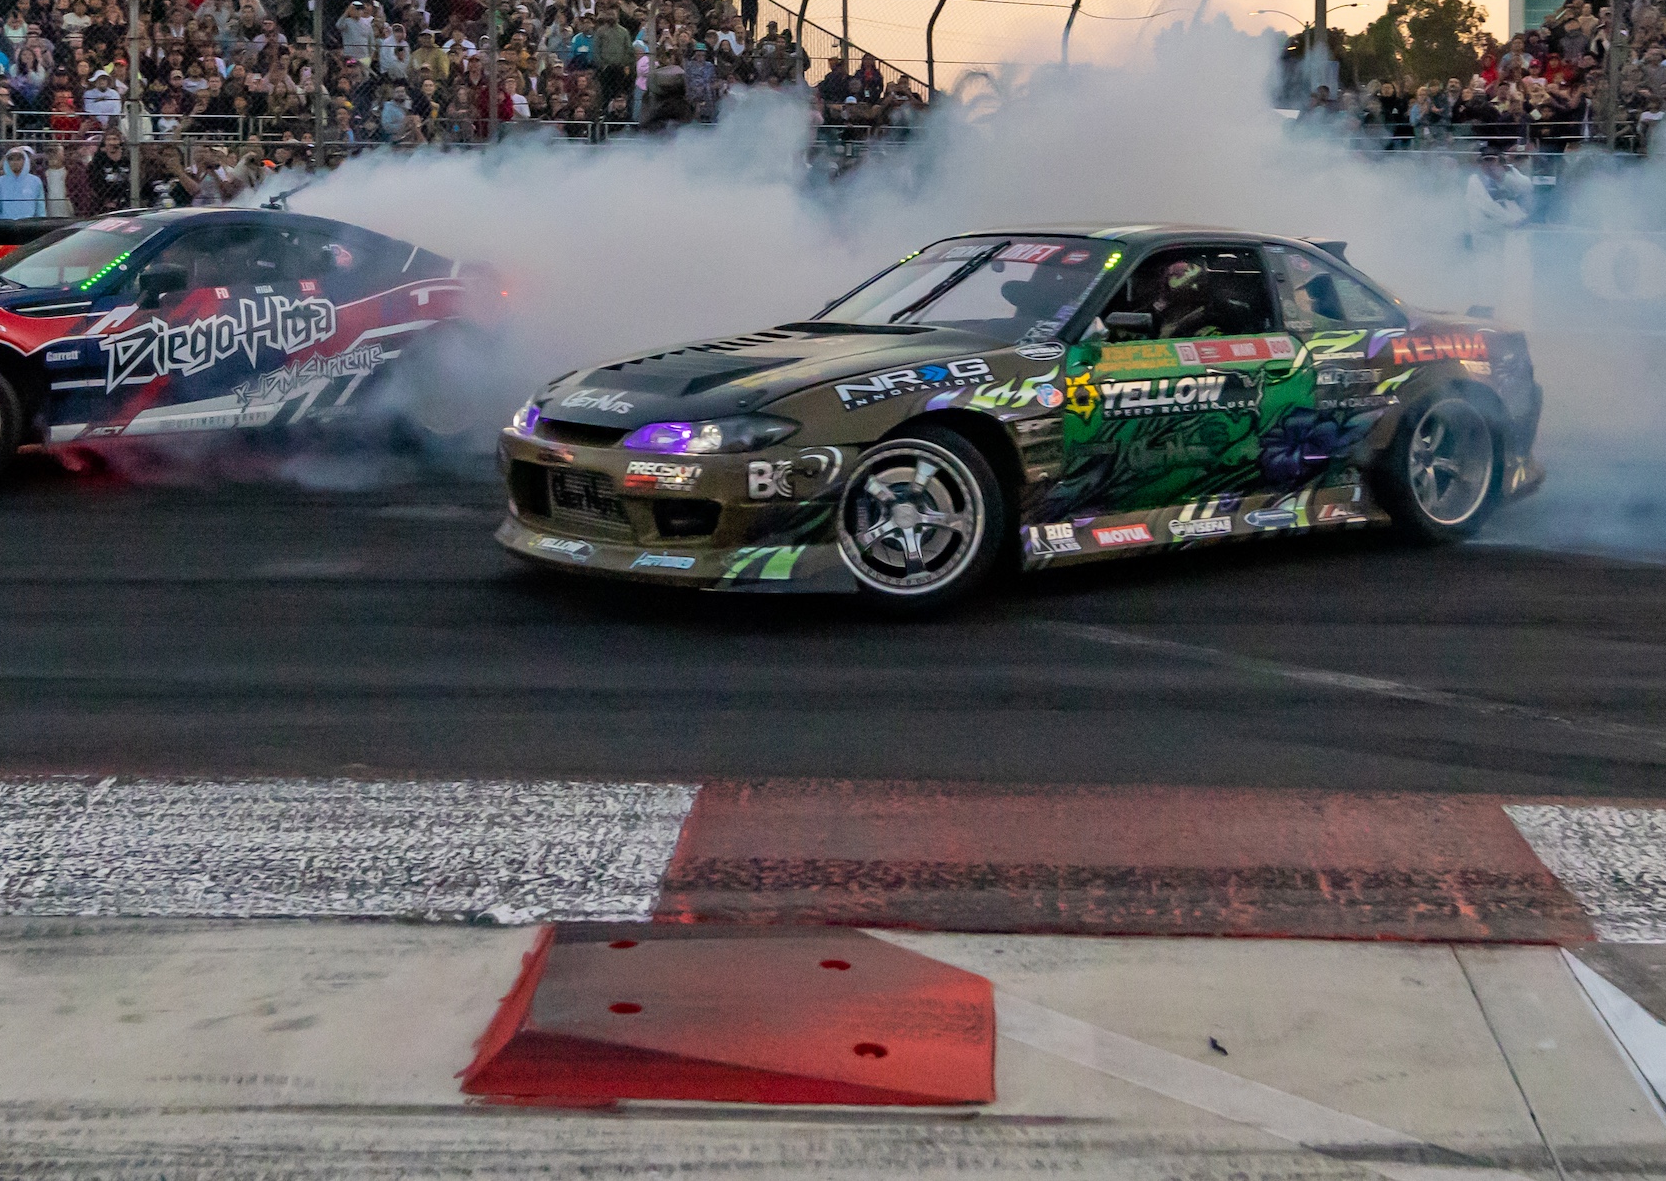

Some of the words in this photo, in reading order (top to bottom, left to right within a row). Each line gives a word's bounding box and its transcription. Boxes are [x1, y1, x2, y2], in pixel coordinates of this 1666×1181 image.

[46, 350, 80, 362] Garrett
[99, 315, 238, 395] Diego
[1391, 332, 1489, 365] KENDA
[844, 374, 995, 410] INNOVATIONS
[1100, 375, 1227, 411] YELLOW
[1103, 407, 1155, 418] SPEED
[1161, 402, 1226, 414] RACING
[1227, 400, 1255, 409] USA
[1044, 522, 1073, 539] BIG
[1097, 527, 1151, 545] MOTUL
